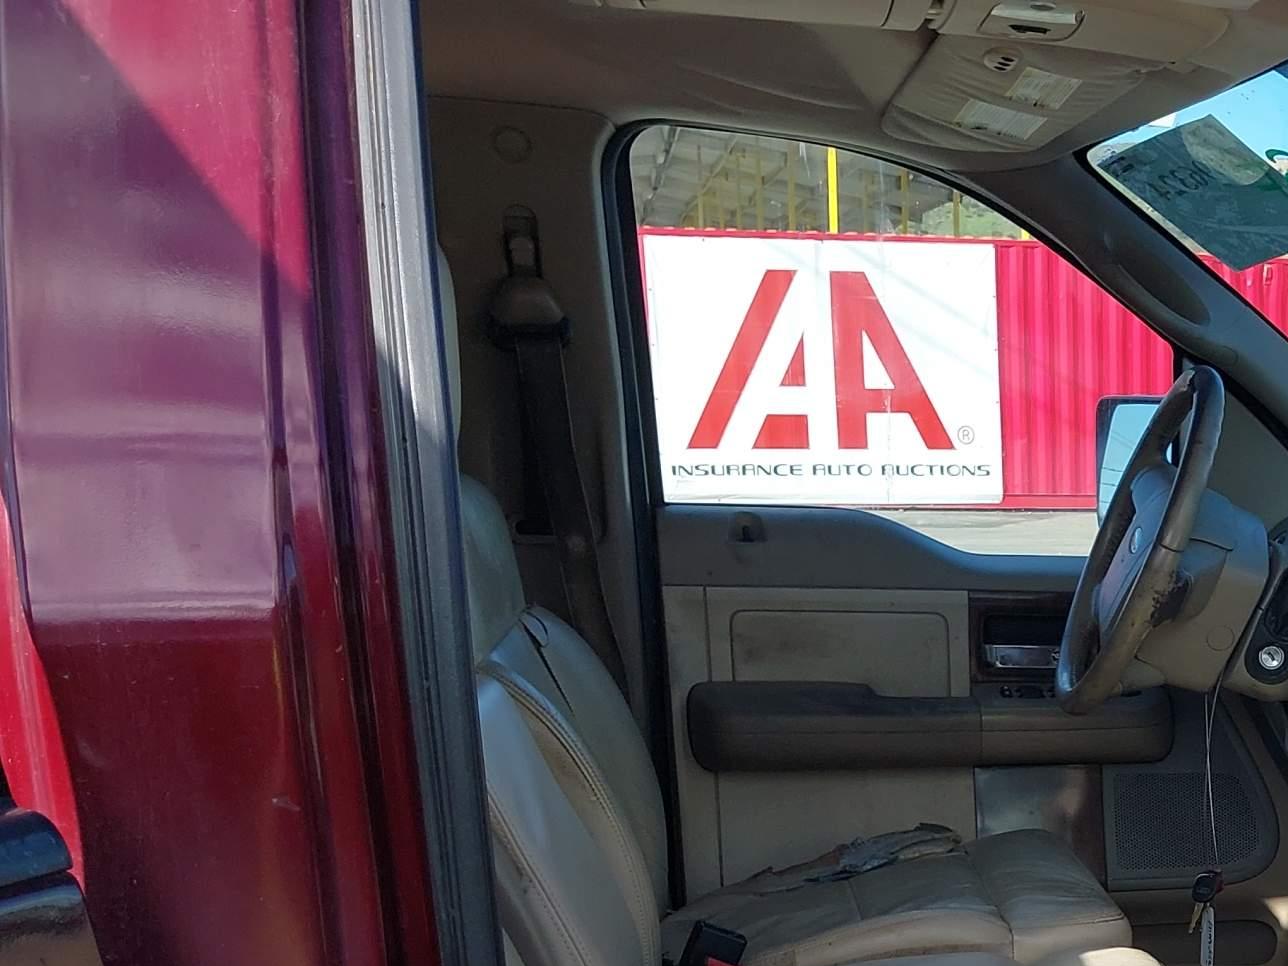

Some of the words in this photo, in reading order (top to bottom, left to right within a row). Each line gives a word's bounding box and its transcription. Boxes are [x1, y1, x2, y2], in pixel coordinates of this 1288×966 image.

[671, 463, 803, 477] INSURANCE
[812, 463, 873, 477] AUTO
[881, 463, 991, 478] AUCTIONS
